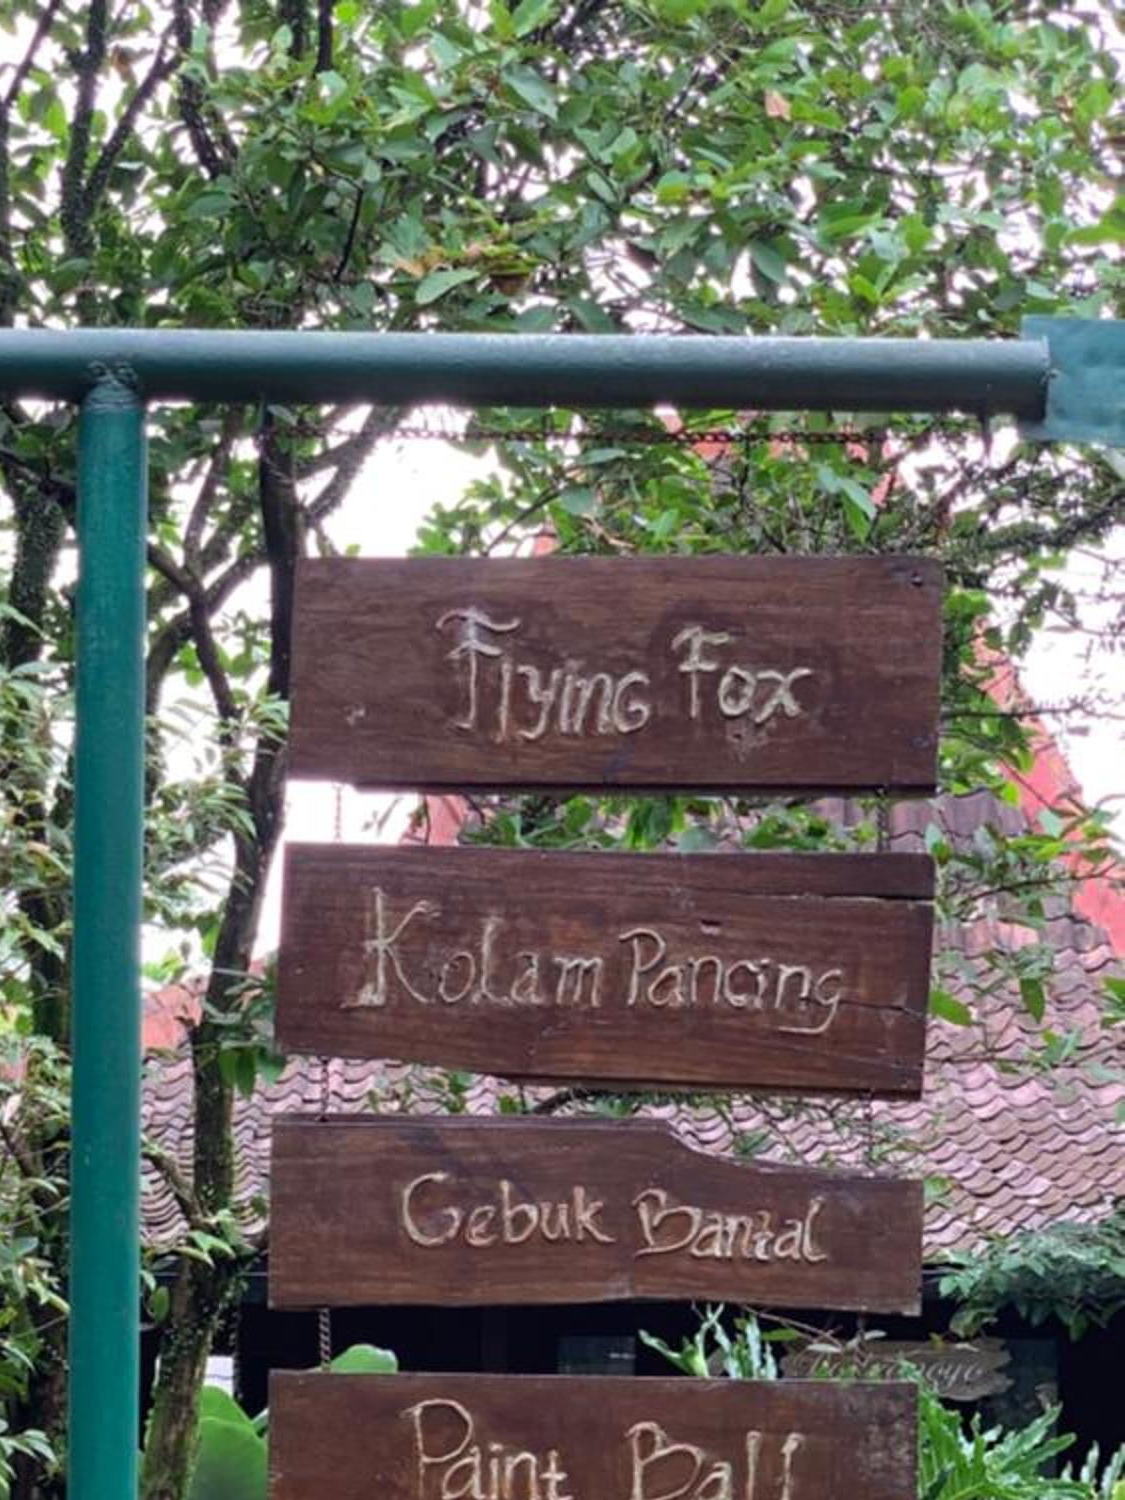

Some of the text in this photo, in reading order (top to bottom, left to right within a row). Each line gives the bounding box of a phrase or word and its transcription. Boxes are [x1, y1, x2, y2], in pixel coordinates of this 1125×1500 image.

[670, 624, 812, 724] Fox
[341, 888, 603, 1008] Kolam
[401, 1172, 827, 1262] Gebuk Bantal
